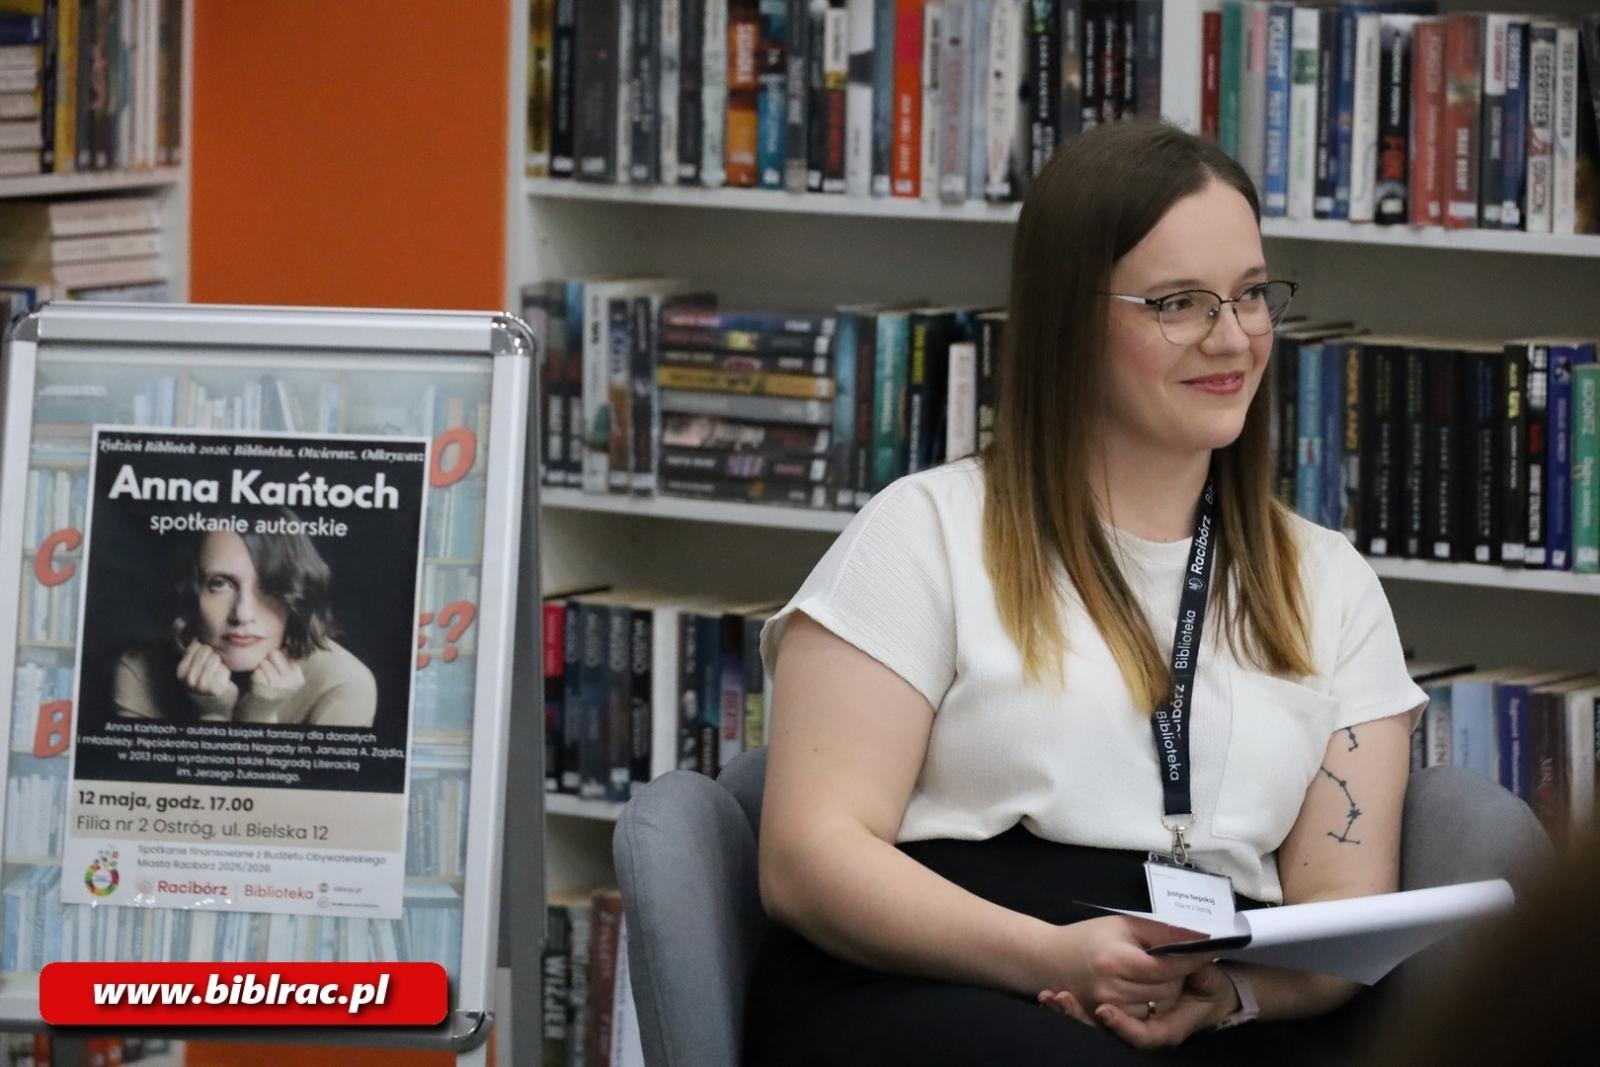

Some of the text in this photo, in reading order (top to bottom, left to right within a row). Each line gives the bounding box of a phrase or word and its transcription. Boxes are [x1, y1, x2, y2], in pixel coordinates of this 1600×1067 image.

[1534, 54, 1551, 129] GERRITSEN
[1561, 75, 1573, 138] GERRITSEN
[1583, 379, 1596, 436] KOONTZ
[145, 441, 196, 454] Bibliotek
[234, 444, 296, 457] Biblioteka.
[299, 446, 358, 460] Otwierasz.
[109, 464, 399, 509] Anna Kańtoch
[150, 511, 349, 538] spotkanie autorskie
[1191, 515, 1211, 575] Racibórz
[1174, 609, 1196, 669] Biblioteka
[104, 722, 132, 733] Anna
[134, 722, 177, 734] Kańtoch
[186, 726, 226, 736] autorka
[228, 727, 265, 739] książek
[266, 728, 306, 742] fantasy
[307, 730, 325, 741] dla
[325, 731, 377, 744] dorosłych
[136, 737, 199, 749] Pięciokrotna
[200, 739, 249, 751] laureatka
[251, 742, 296, 755] Nagrody
[297, 744, 313, 754] im.
[314, 745, 358, 756] Janusza
[359, 747, 370, 757] A.
[1156, 711, 1182, 781] Biblioteka
[117, 752, 127, 760] w
[128, 751, 150, 762] 2013
[152, 752, 174, 762] roku
[177, 753, 236, 765] wyróżniona
[236, 755, 265, 767] także
[265, 757, 312, 770] Nagrodą
[176, 767, 192, 777] im.
[194, 768, 235, 781] Jerzego
[77, 790, 254, 813] 12 maja, godz. 17.00
[77, 815, 329, 841] Filia nr 2 Ostróg, ul. Bielska 12
[137, 844, 189, 858] Spotkanie
[190, 846, 255, 860] finansowane
[263, 849, 306, 861] Budżetu
[306, 852, 387, 867] Obywatelskiego
[137, 858, 171, 869] Miasta
[173, 859, 217, 872] Racibórz
[157, 879, 228, 896] Racibórz
[244, 884, 315, 901] Biblioteka
